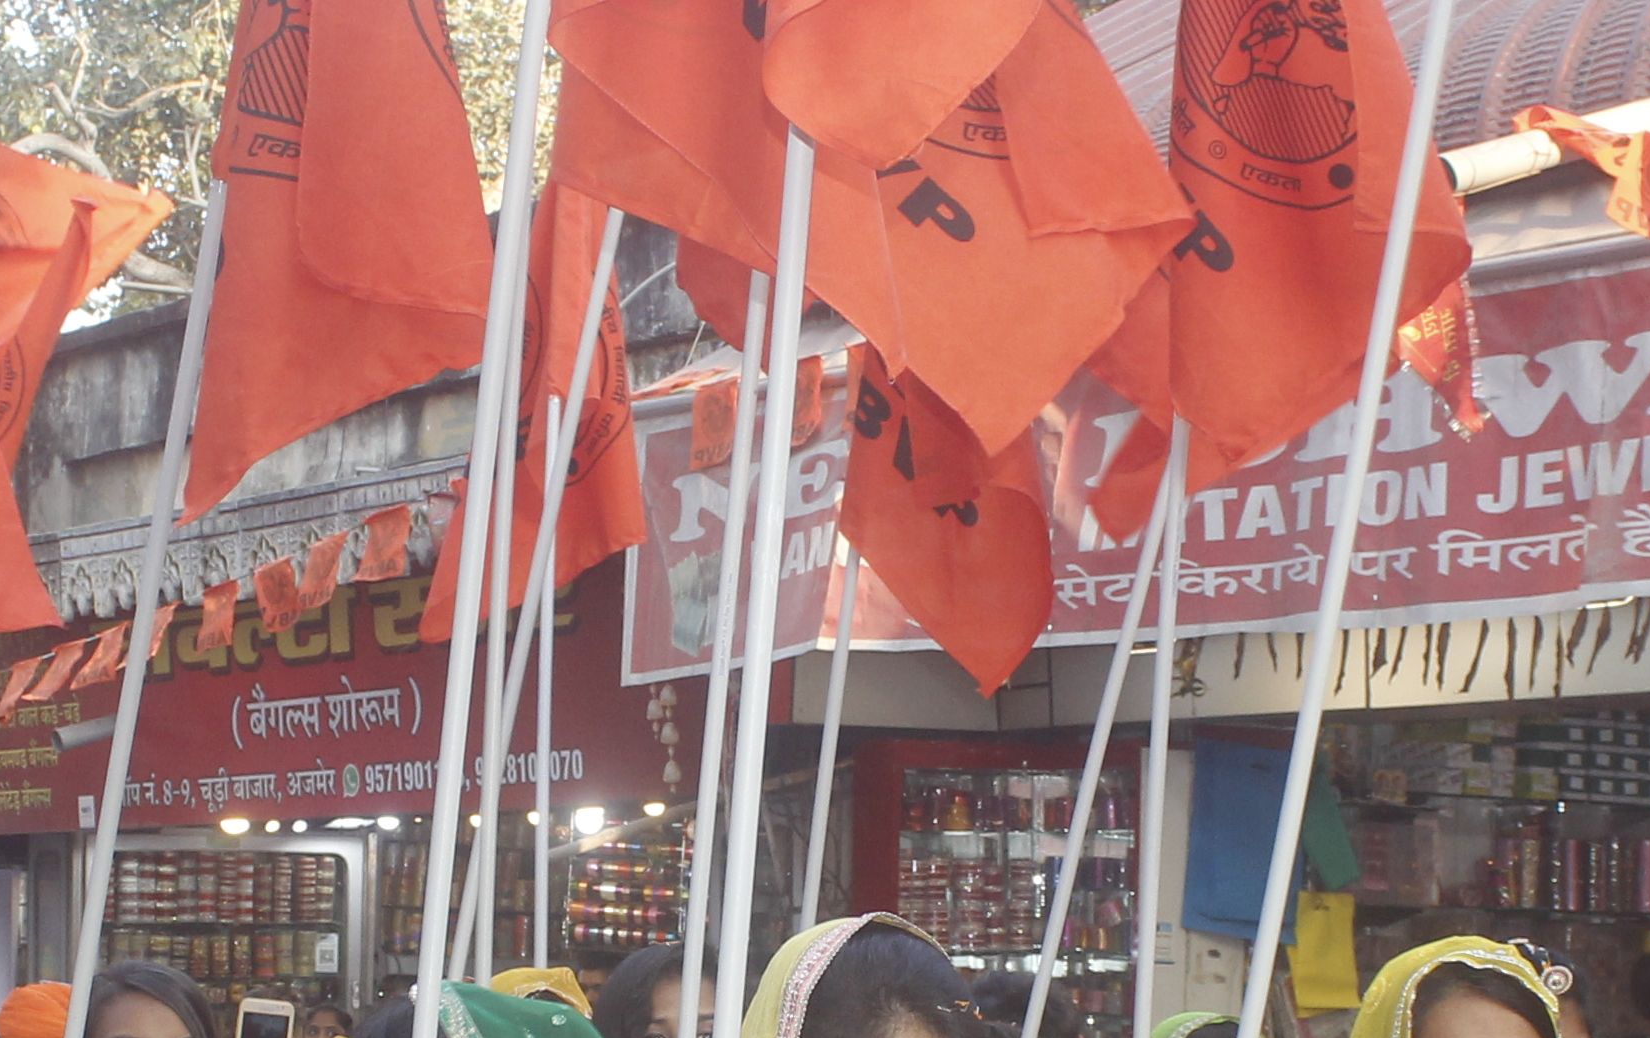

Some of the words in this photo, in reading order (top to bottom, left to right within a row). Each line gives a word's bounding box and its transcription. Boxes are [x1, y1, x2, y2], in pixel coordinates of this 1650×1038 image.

[246, 132, 302, 159] एक
[962, 120, 1008, 143] एक
[1350, 546, 1418, 583] पर
[1430, 511, 1600, 577] मिलते
[286, 757, 336, 798] अजमेर
